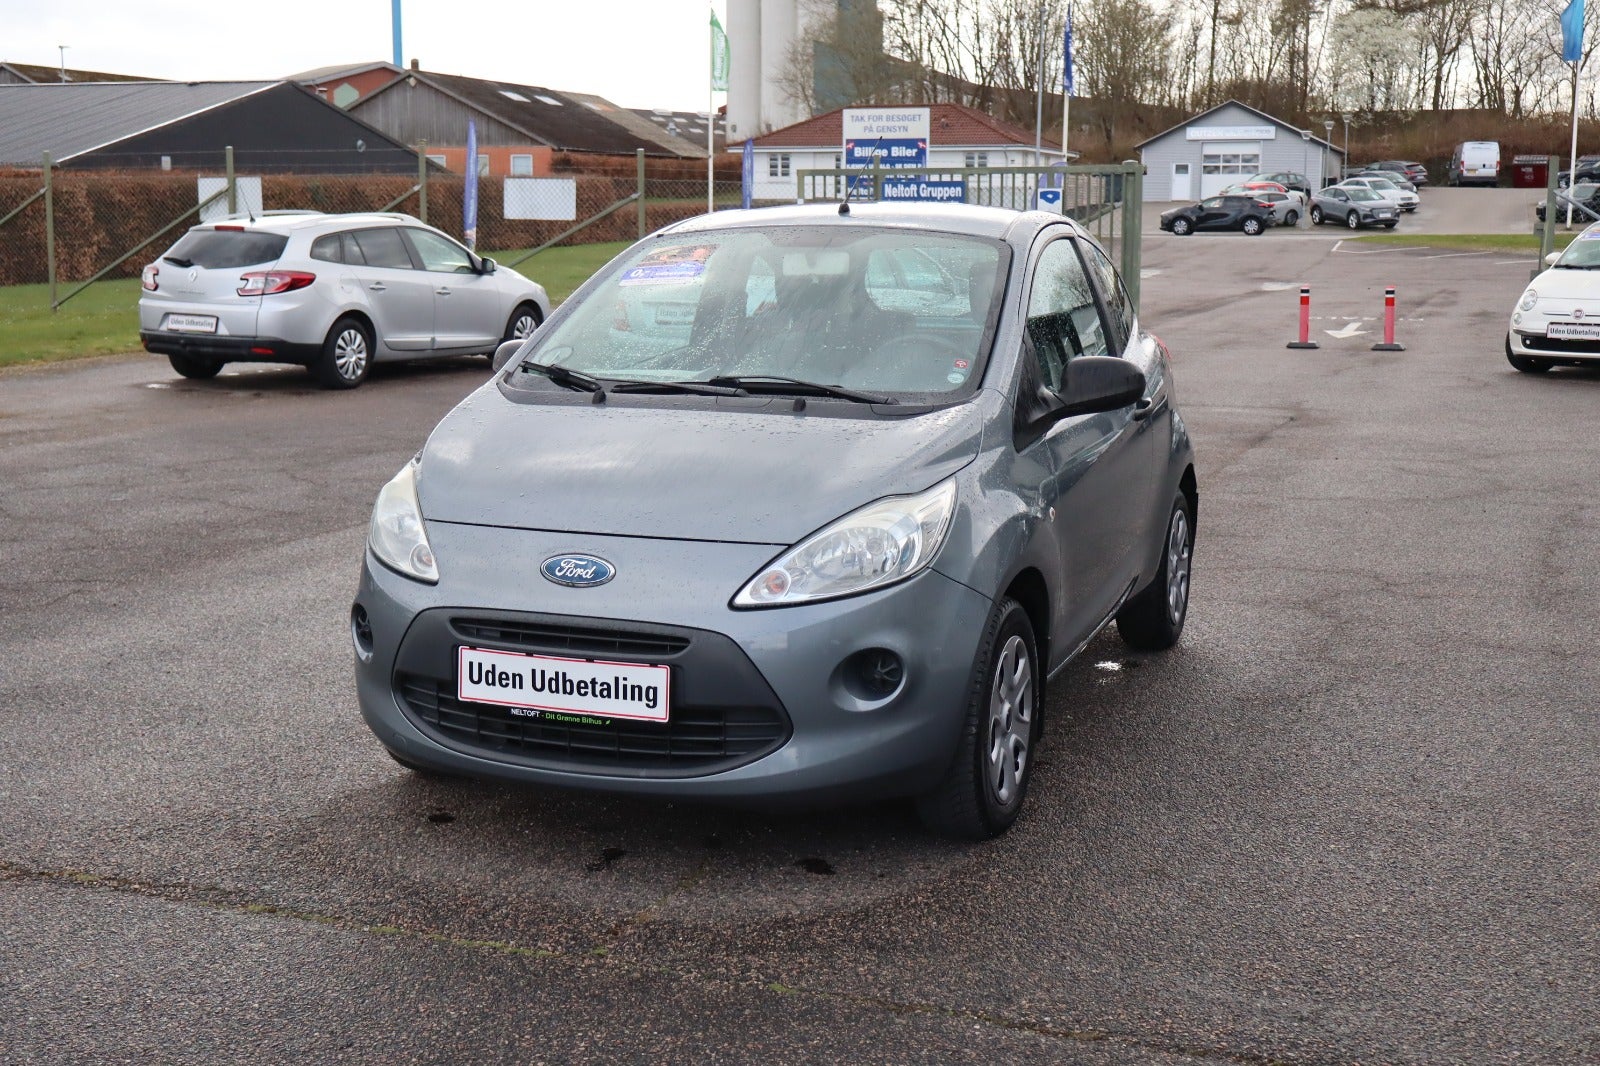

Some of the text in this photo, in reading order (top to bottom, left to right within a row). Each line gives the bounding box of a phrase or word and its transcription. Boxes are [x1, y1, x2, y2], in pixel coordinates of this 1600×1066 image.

[886, 114, 922, 122] BESØGET
[863, 125, 909, 133] PÅ GENSYN
[891, 146, 918, 157] Biler
[884, 183, 962, 199] Neltoft Gruppen
[1566, 328, 1600, 337] Udbetaling
[555, 558, 597, 579] Ford
[468, 660, 658, 709] Uden Udbetaling
[510, 708, 541, 718] NELTOFT
[545, 712, 555, 720] Dit
[581, 716, 602, 725] Bilhus
